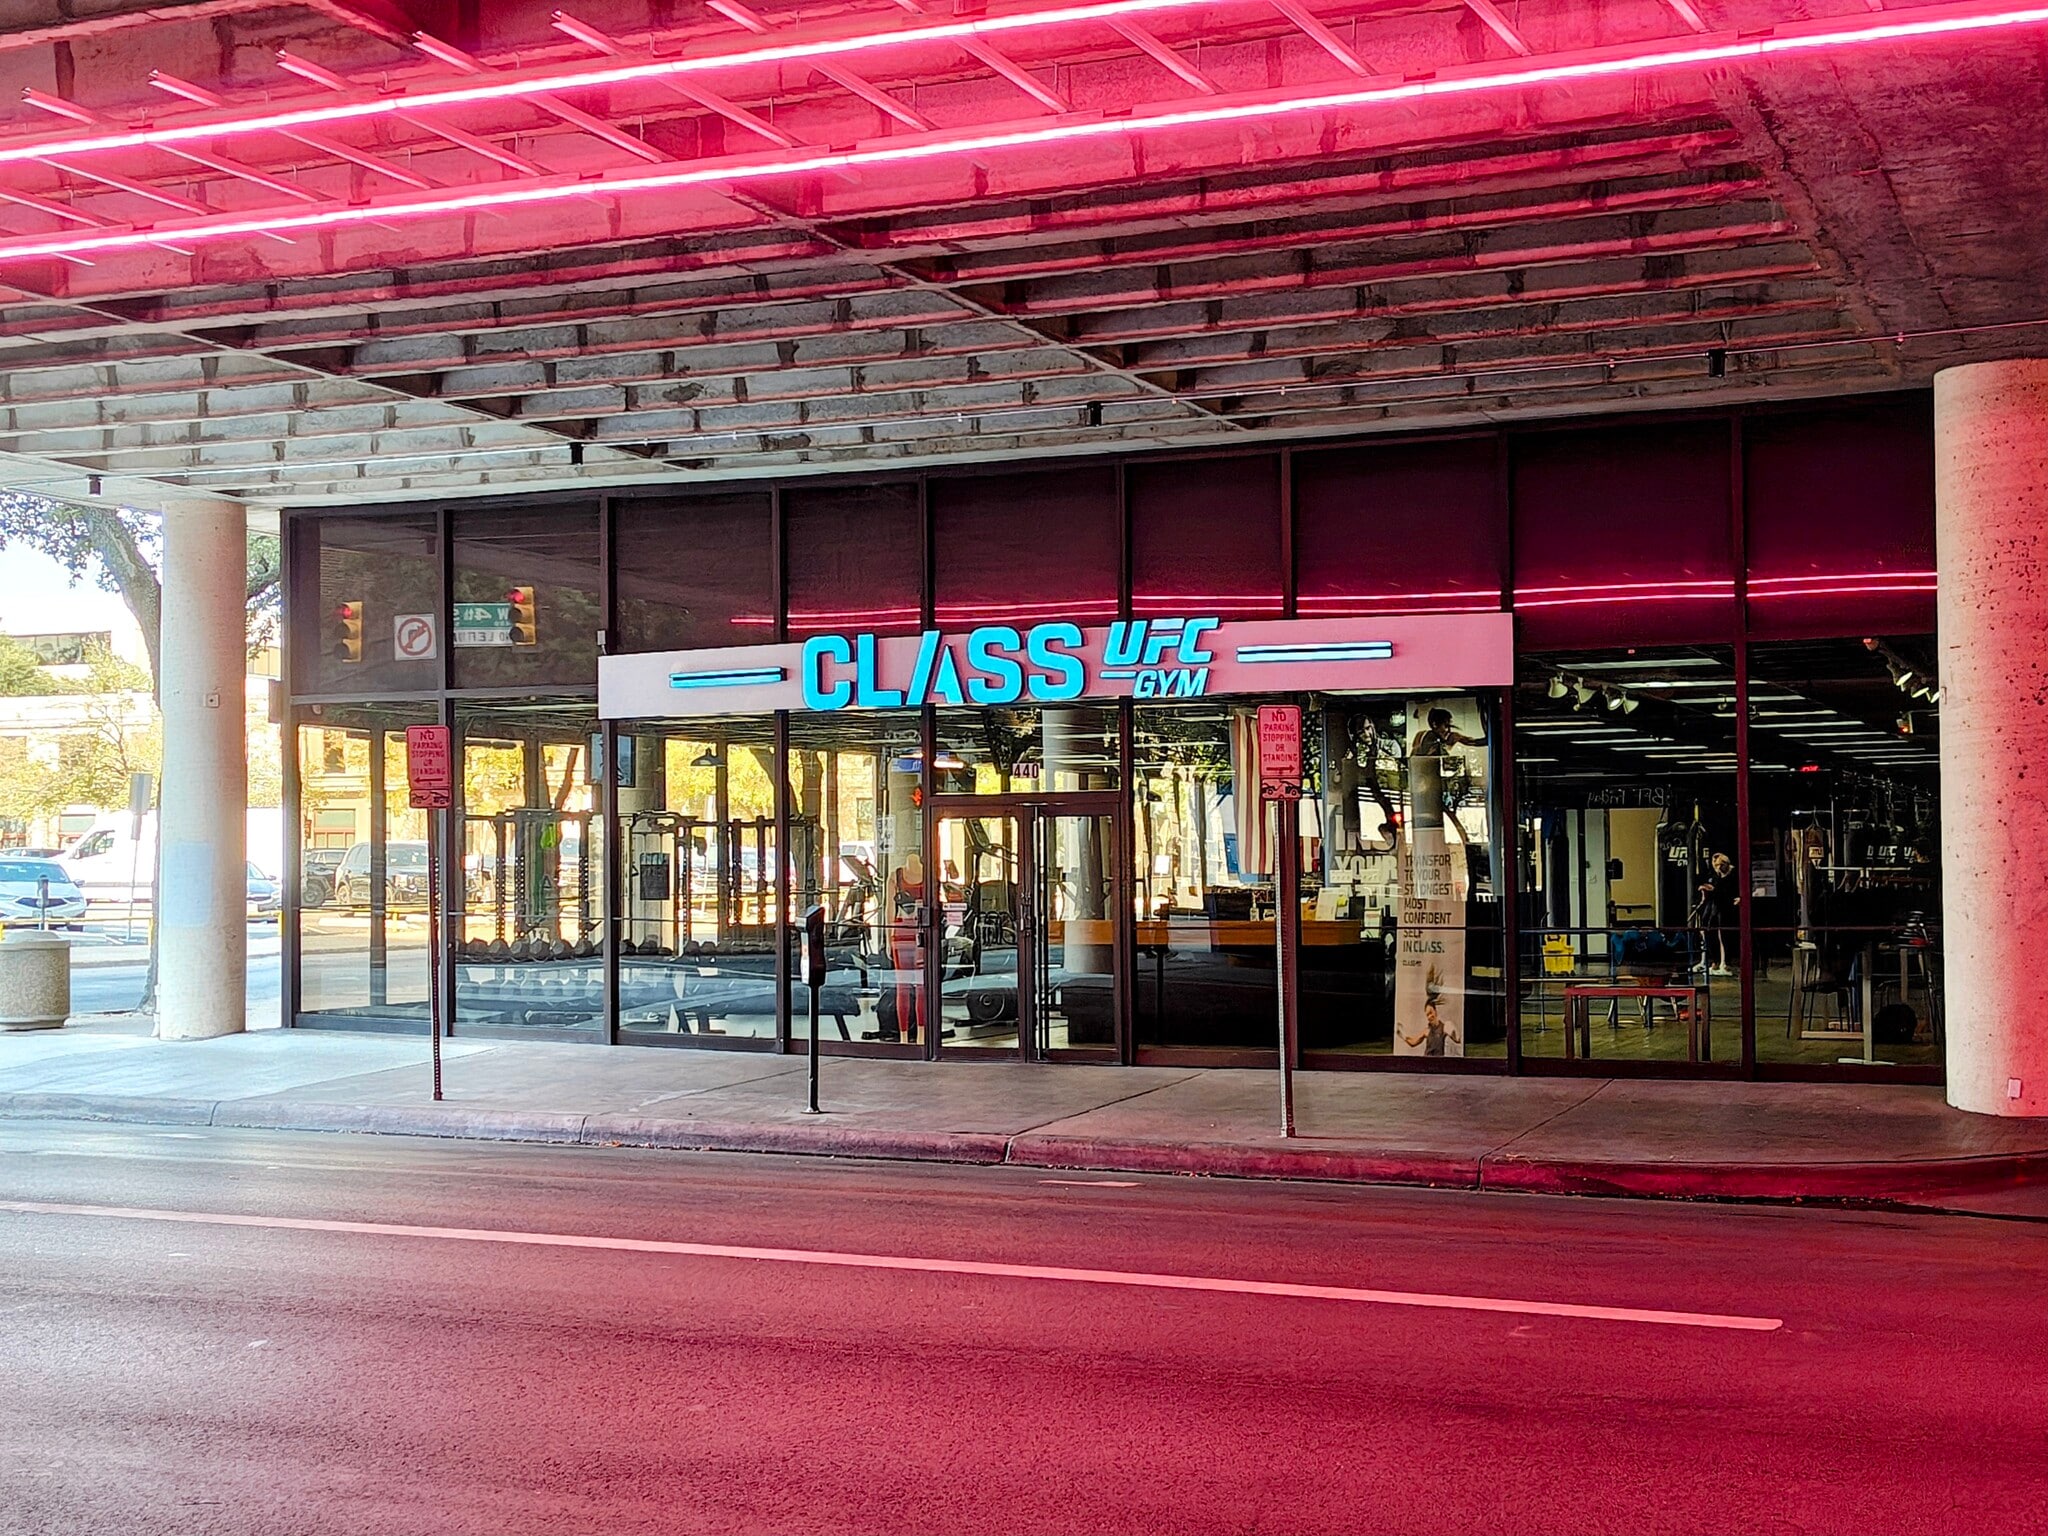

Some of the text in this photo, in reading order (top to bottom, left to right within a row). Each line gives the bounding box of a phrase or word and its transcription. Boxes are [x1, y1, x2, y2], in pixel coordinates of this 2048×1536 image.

[1104, 617, 1220, 665] UFC
[802, 623, 1084, 710] CLASS
[1133, 669, 1208, 699] GYM
[1271, 711, 1286, 722] NO
[1264, 723, 1295, 732] PARKING
[420, 731, 435, 741] NO
[1263, 733, 1297, 742] STOPPING
[412, 741, 443, 749] PARKING
[1275, 743, 1285, 752] OR
[411, 750, 445, 758] STOPPING
[1263, 753, 1298, 762] STANDING
[1013, 764, 1038, 779] 440
[1404, 883, 1454, 896] STONGEST
[1403, 898, 1428, 910] MOST
[1403, 912, 1452, 925] CONFIDENT
[1403, 941, 1445, 954] IN CLASS.
